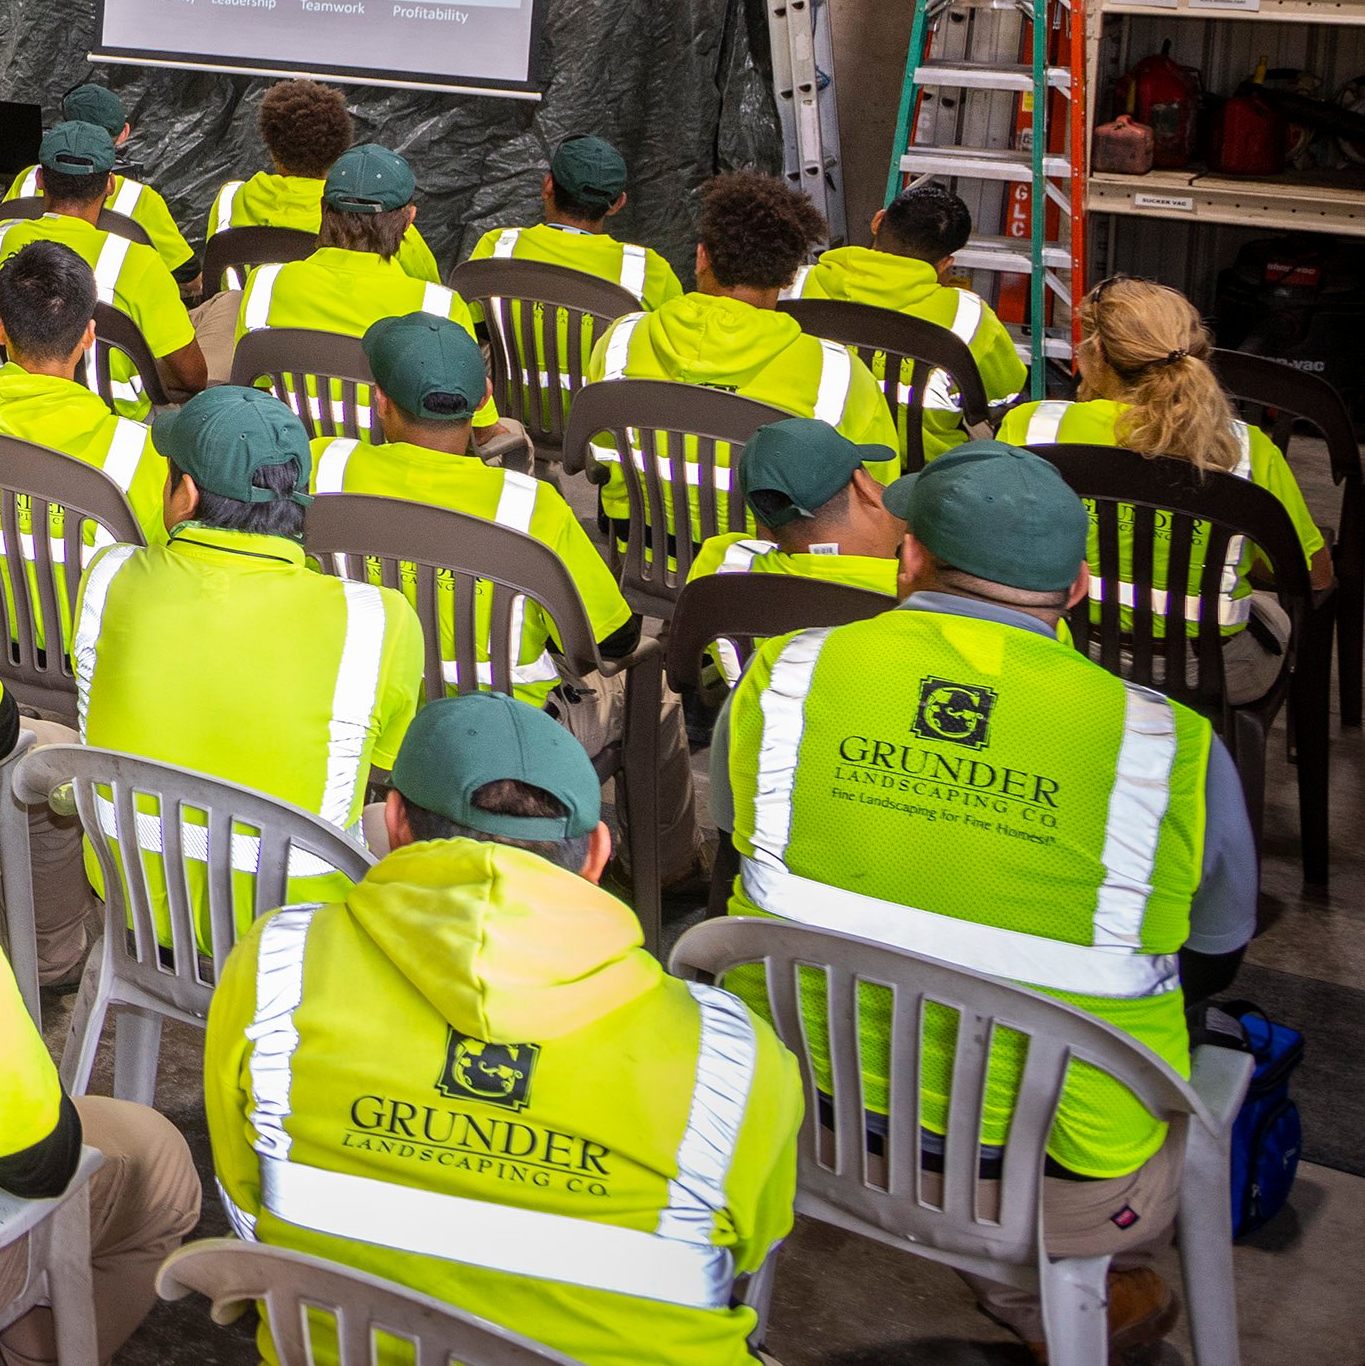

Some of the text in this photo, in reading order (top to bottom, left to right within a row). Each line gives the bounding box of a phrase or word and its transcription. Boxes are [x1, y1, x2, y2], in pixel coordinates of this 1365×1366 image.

[392, 4, 470, 25] Profitability
[1011, 184, 1029, 237] GLC
[1142, 197, 1171, 205] SUCKER
[834, 766, 1059, 830] LANDSCAPING CO.
[838, 735, 1060, 808] GRUNDER
[831, 787, 856, 802] Fine
[859, 792, 937, 823] Landscaping
[940, 809, 960, 822] for
[964, 814, 992, 831] Fine
[349, 1095, 612, 1175] GRUNDER
[342, 1133, 611, 1198] LANDSCAPING CO.
